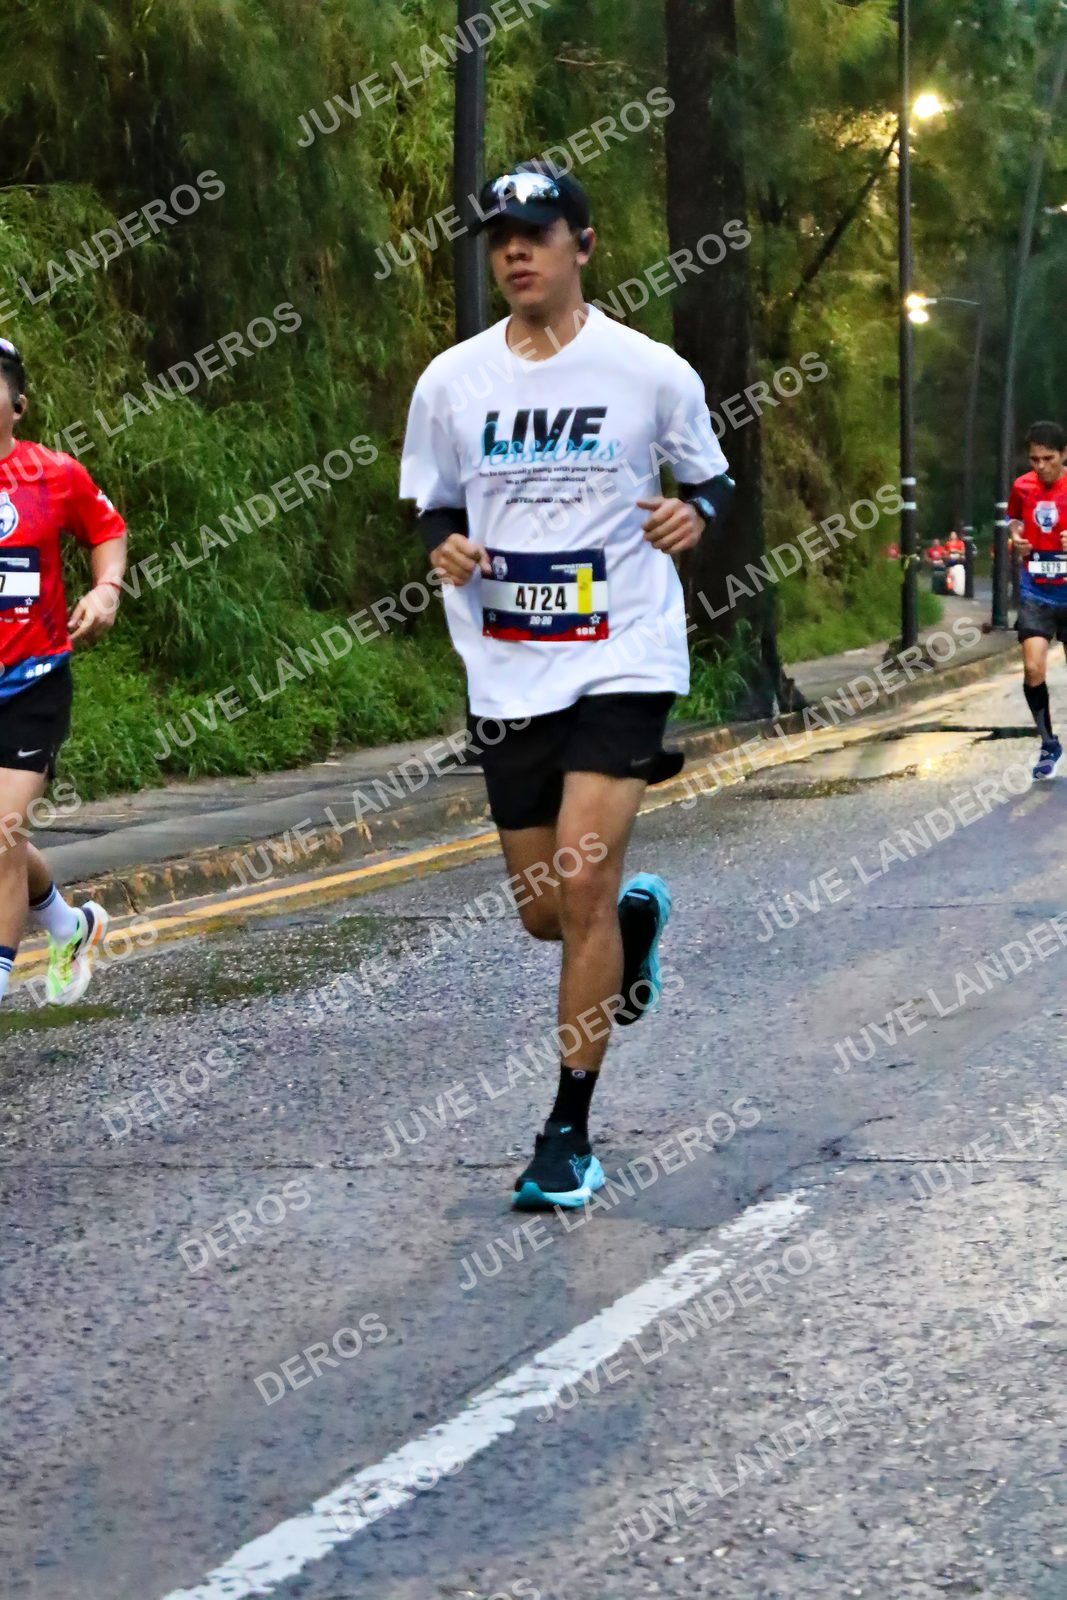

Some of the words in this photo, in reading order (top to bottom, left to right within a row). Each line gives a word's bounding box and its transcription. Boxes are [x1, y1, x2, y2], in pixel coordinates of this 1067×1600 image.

[484, 406, 608, 456] LIVE
[515, 585, 568, 611] 4724
[576, 626, 596, 635] 10K
